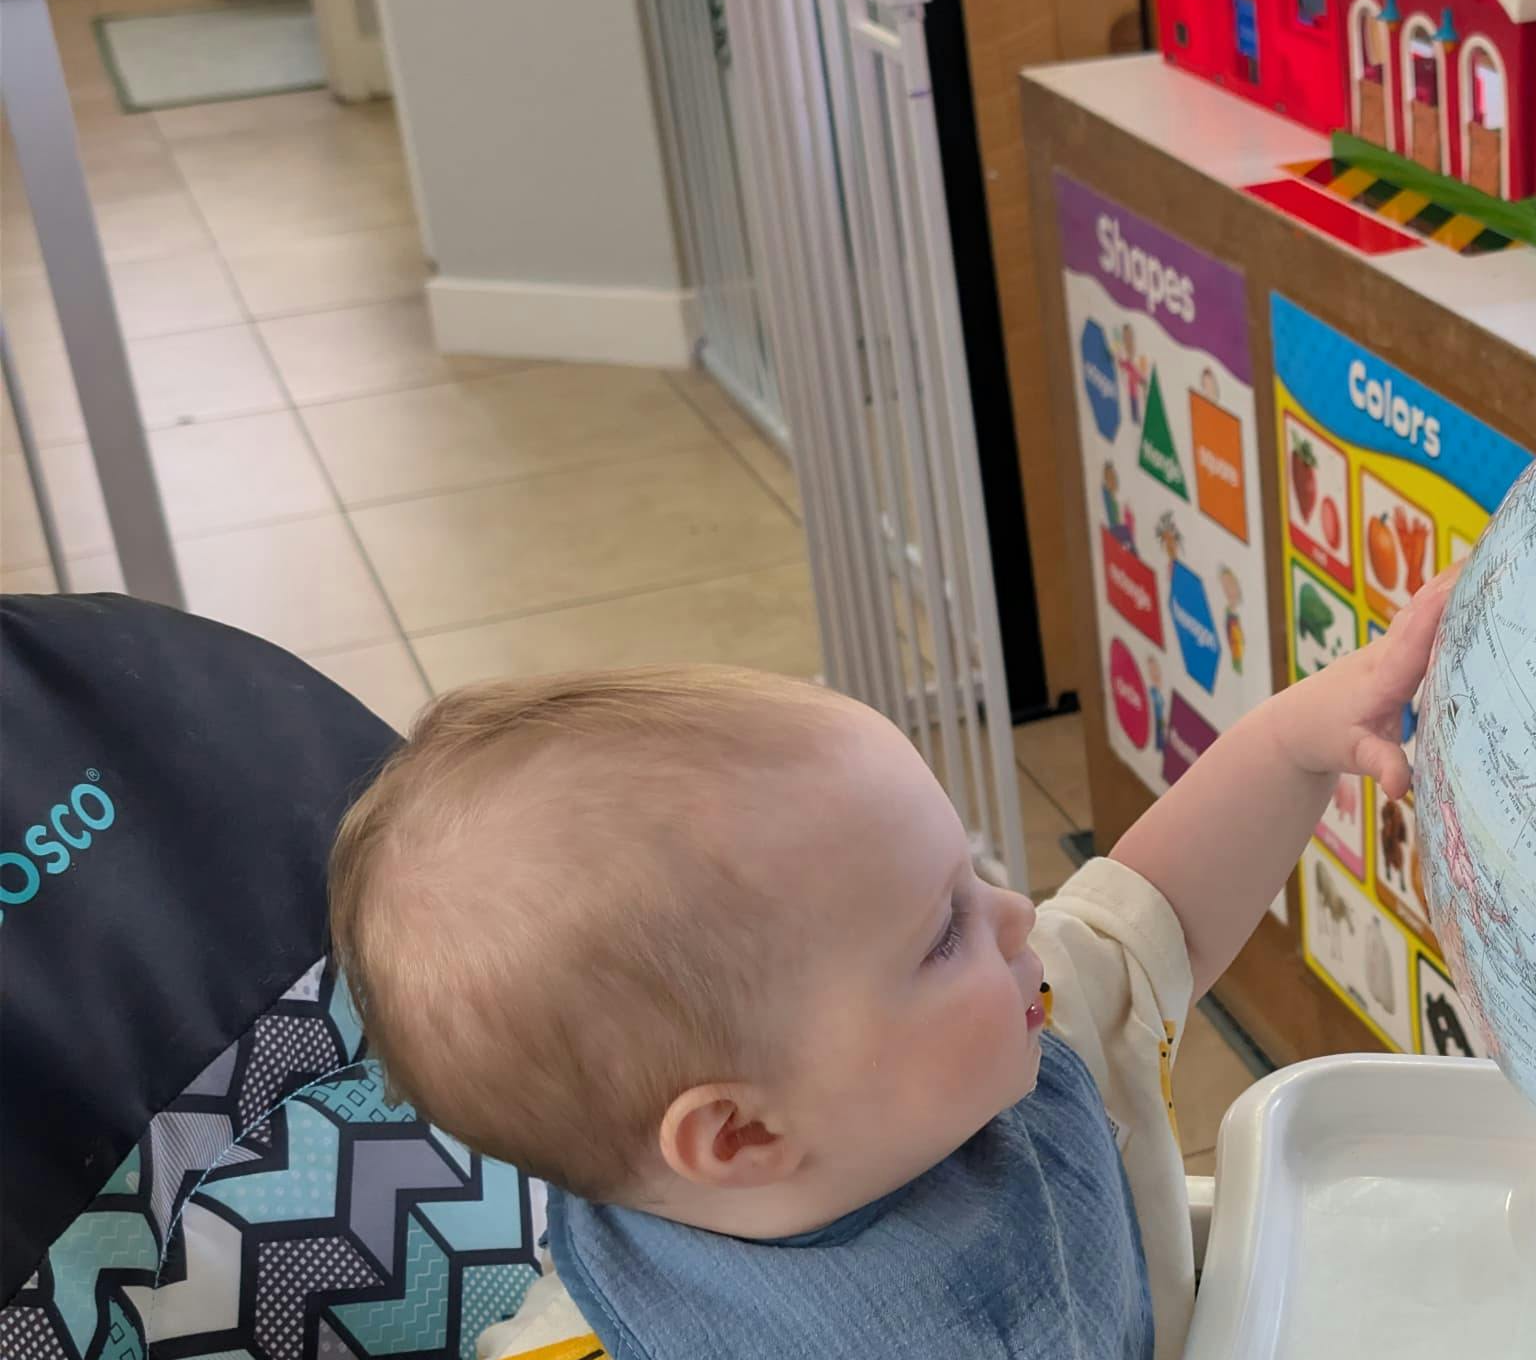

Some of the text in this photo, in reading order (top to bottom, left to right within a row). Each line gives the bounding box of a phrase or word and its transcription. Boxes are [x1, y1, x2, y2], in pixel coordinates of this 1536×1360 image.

[1096, 213, 1196, 323] Shapes
[1349, 359, 1442, 460] Colors
[0, 767, 117, 928] OSCO®
